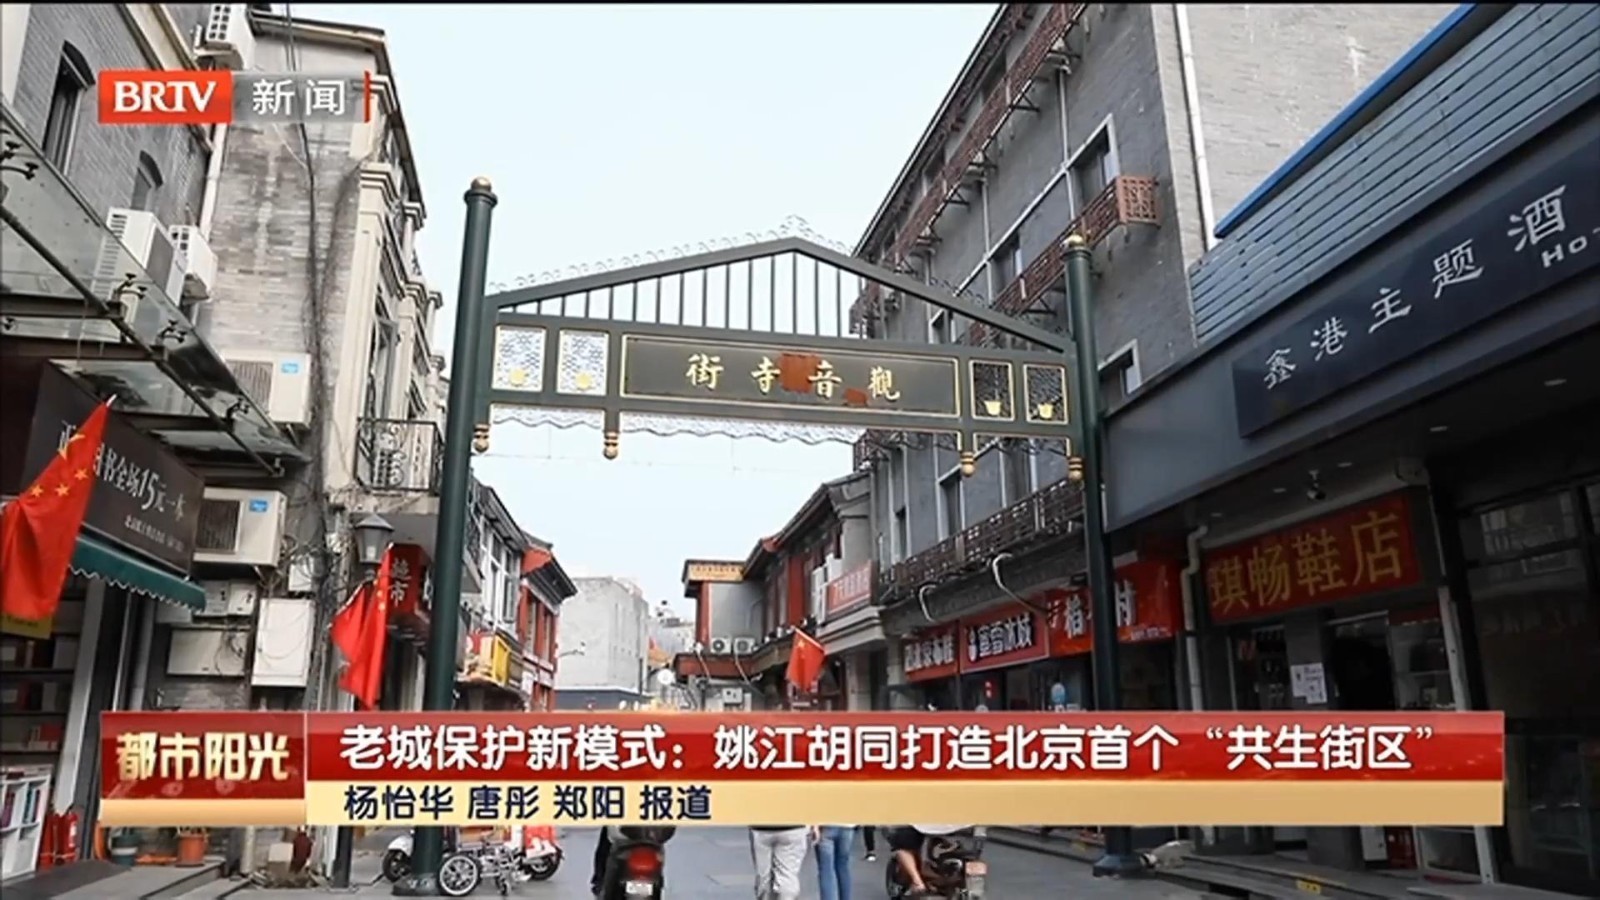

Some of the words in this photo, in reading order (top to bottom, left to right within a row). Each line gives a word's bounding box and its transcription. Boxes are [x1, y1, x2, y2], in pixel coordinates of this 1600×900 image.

[1264, 185, 1566, 390] 鑫港主题酒
[1208, 509, 1405, 613] 琪畅鞋店
